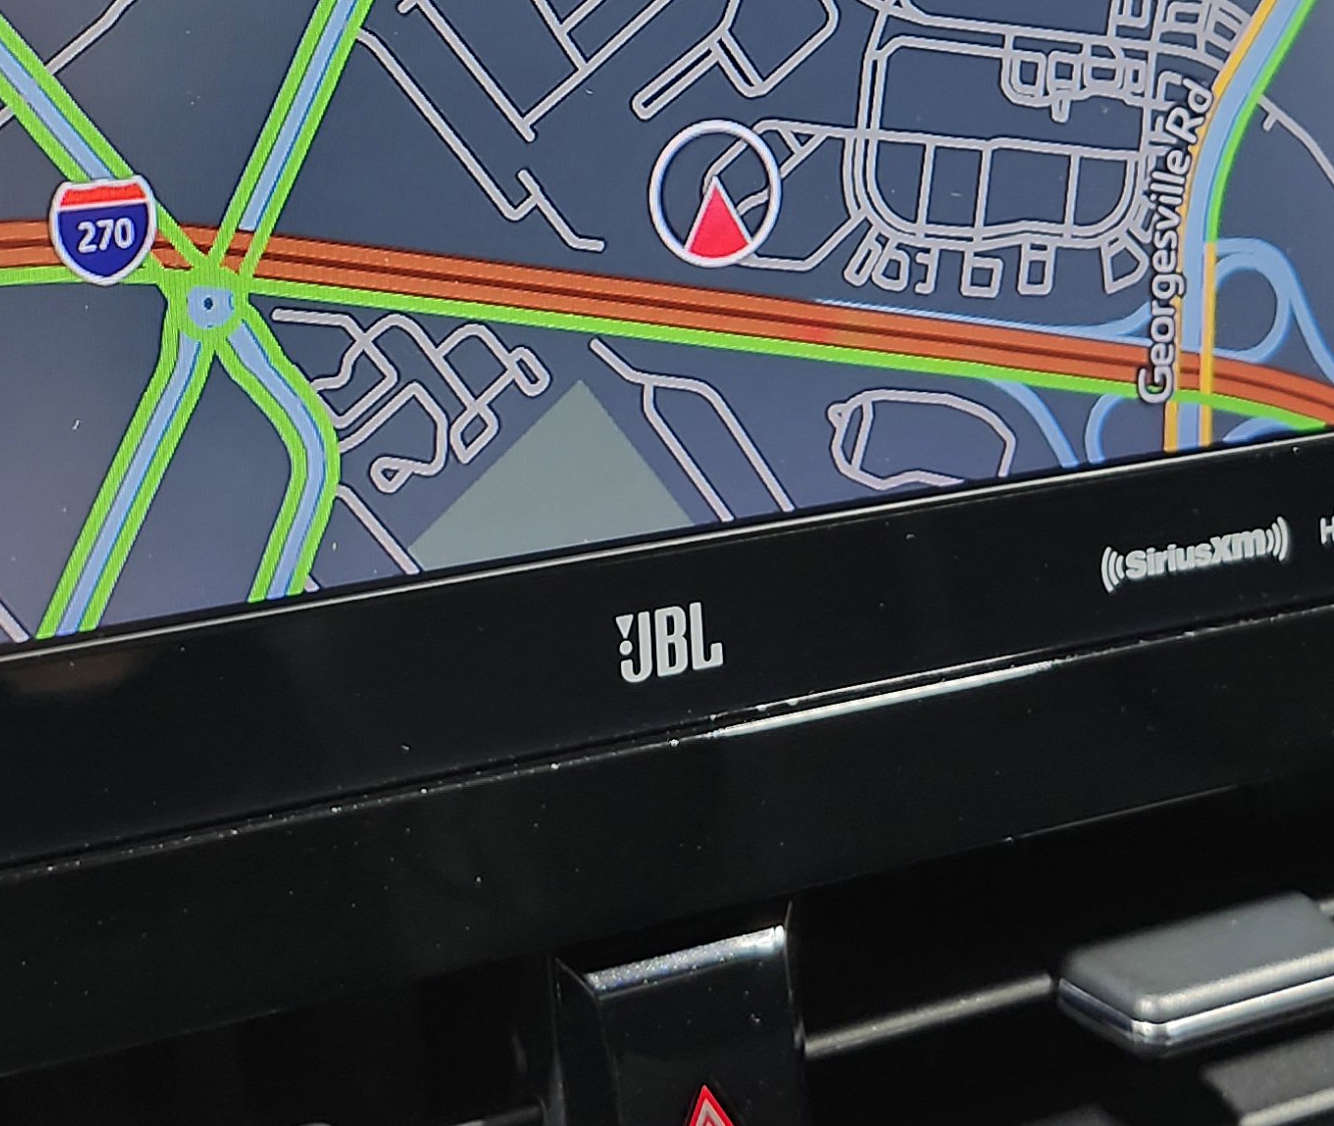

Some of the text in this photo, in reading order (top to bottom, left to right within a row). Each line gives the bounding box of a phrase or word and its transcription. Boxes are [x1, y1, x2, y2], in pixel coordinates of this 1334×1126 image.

[77, 217, 135, 254] 270
[1138, 77, 1214, 405] Georgesville Rd
[619, 601, 725, 683] JBL
